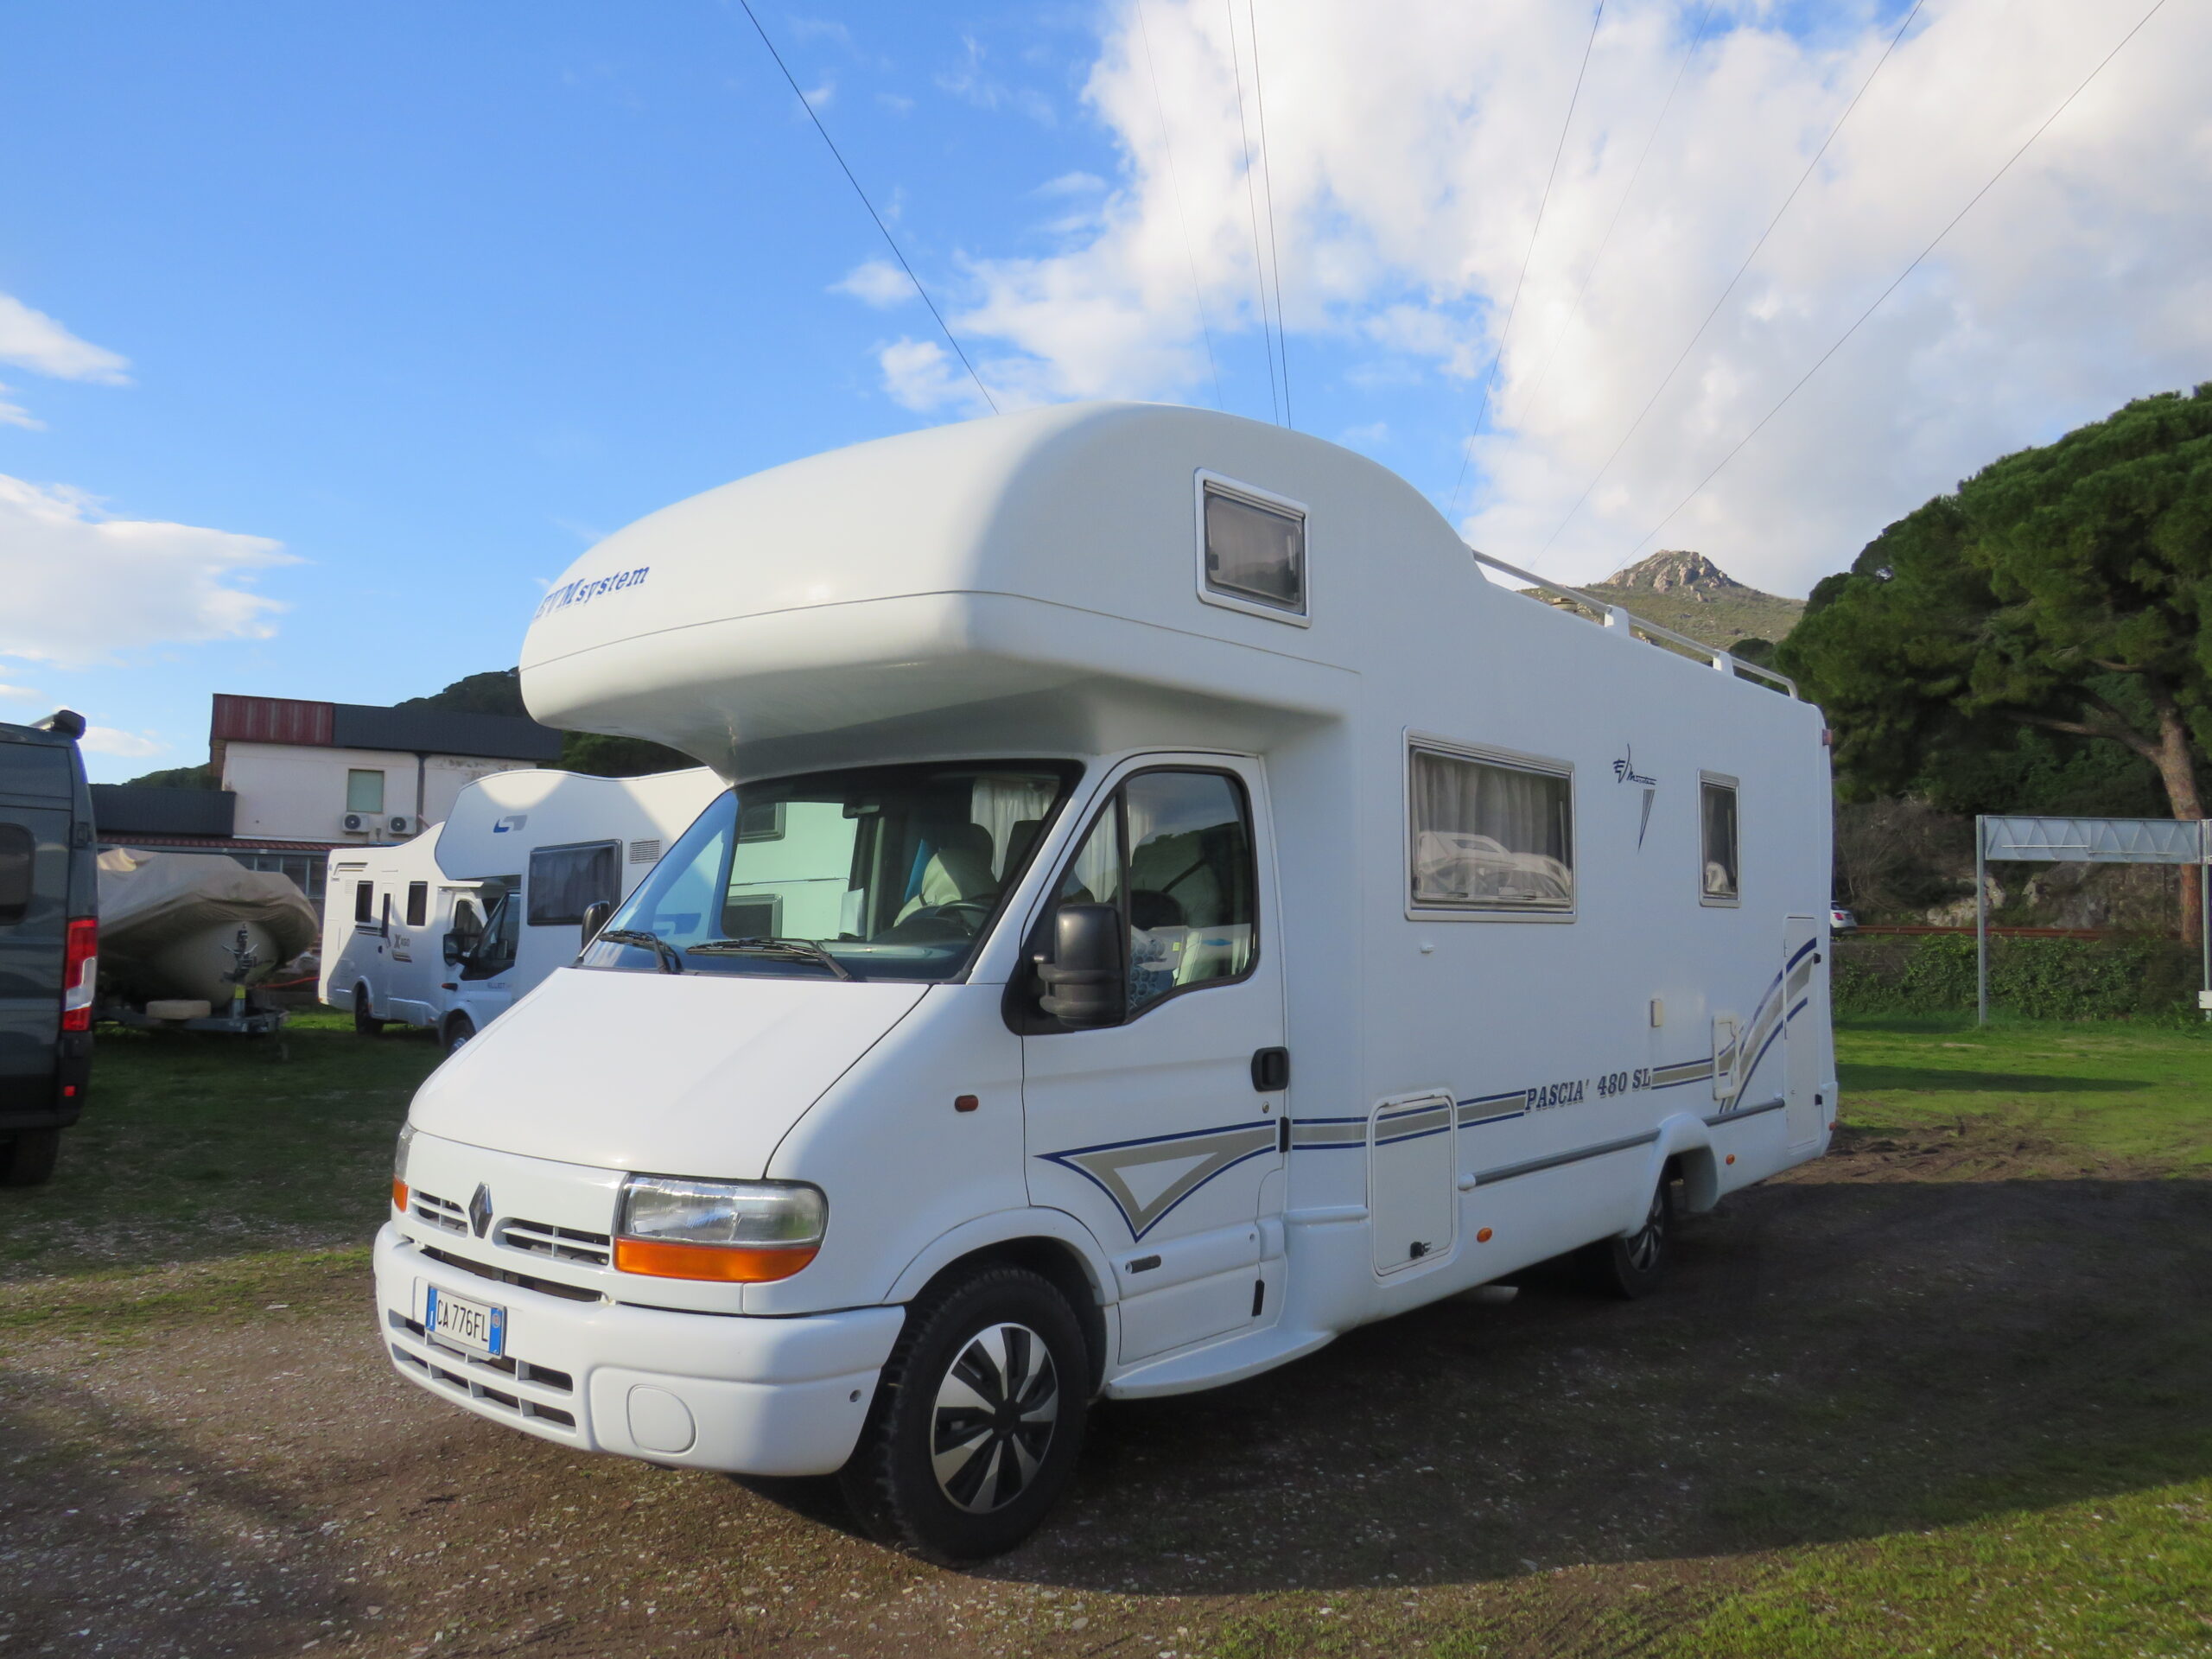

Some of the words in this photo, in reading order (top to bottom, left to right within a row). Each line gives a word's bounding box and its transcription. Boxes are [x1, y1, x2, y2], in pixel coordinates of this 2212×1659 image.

[1525, 1079, 1590, 1112] PASCIA'
[1597, 1071, 1628, 1098] 480
[1631, 1067, 1651, 1091] SL
